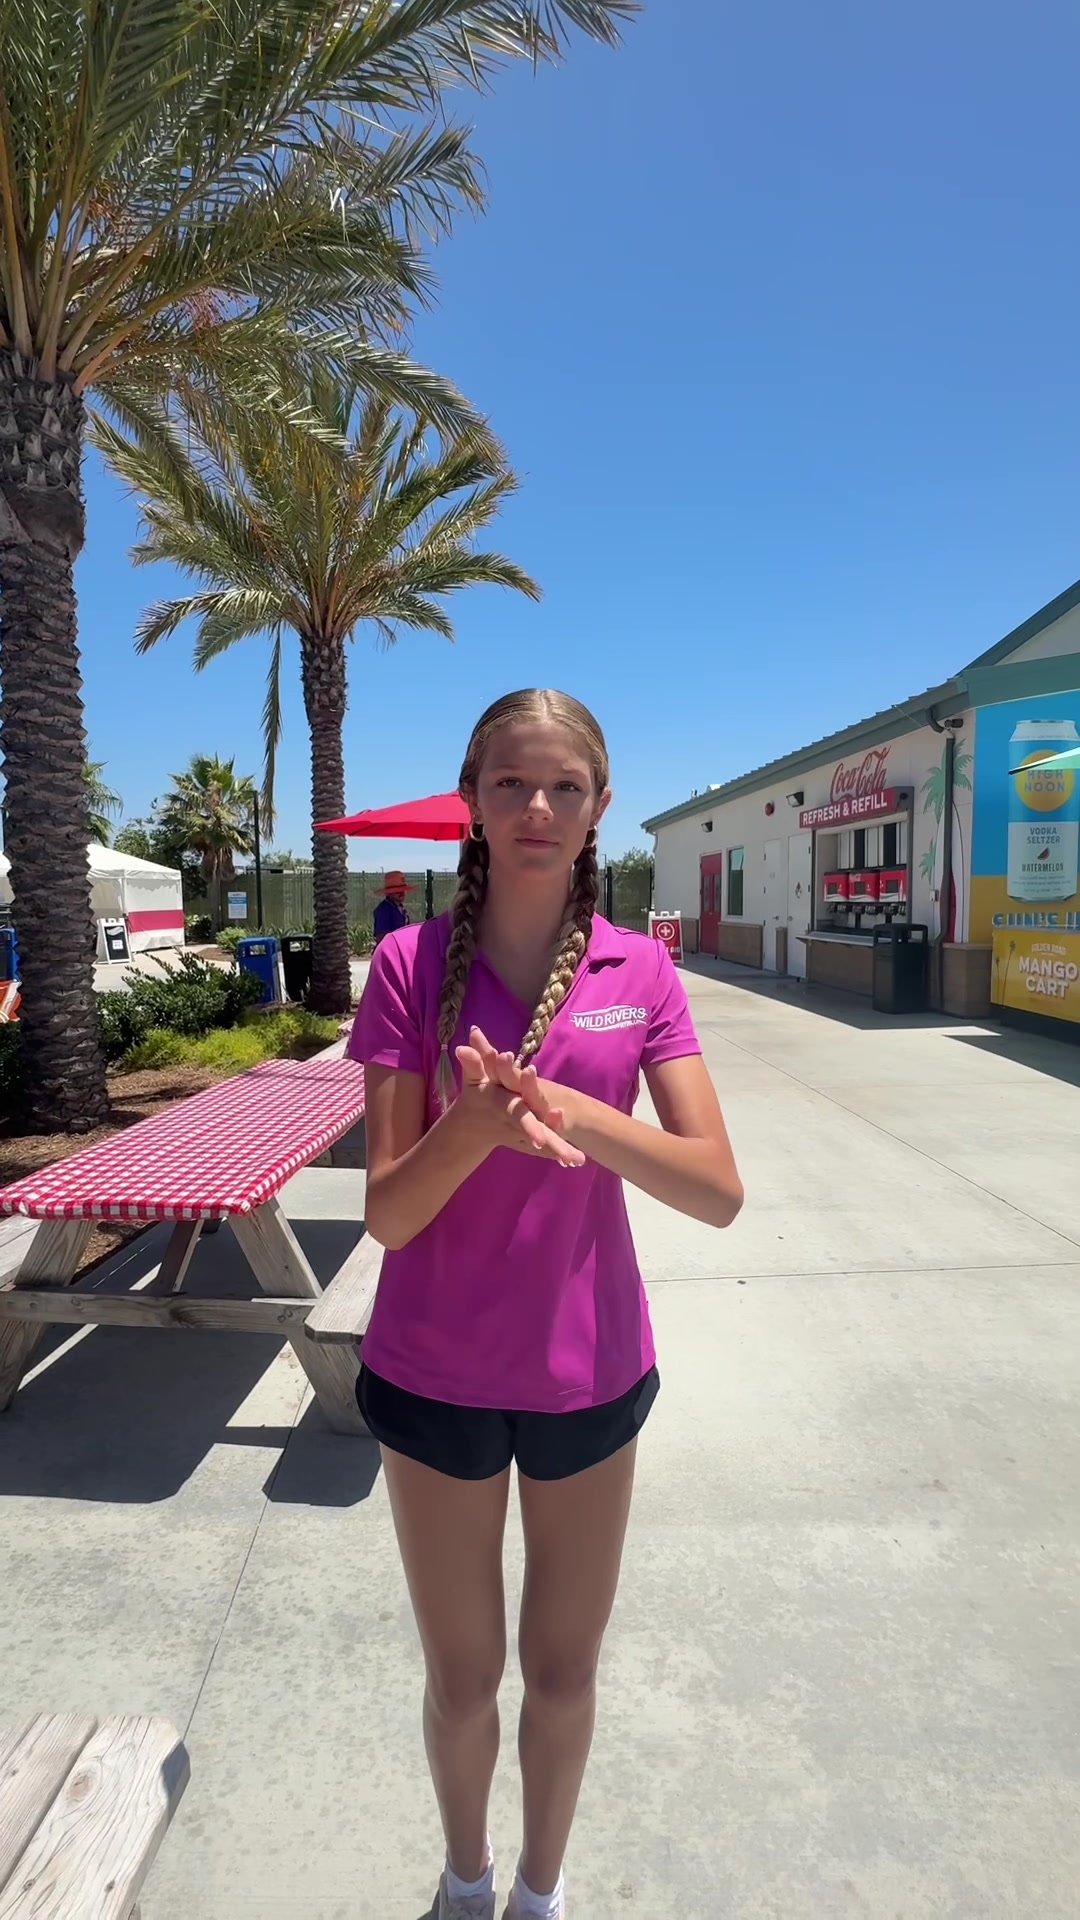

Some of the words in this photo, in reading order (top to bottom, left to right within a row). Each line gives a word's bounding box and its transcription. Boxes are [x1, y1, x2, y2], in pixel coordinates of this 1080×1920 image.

[1028, 770, 1063, 779] HIGH
[1025, 782, 1064, 792] NOON
[802, 803, 841, 826] REFRESH
[842, 801, 850, 817] &
[851, 791, 888, 815] REFILL
[1030, 827, 1057, 835] VODKA
[1027, 836, 1061, 844] SELTZER
[1022, 863, 1064, 872] WATERMELON
[1019, 956, 1079, 981] MANGO
[1026, 975, 1069, 998] CART
[573, 1015, 603, 1028] WILD
[604, 1007, 647, 1026] RIVERS
